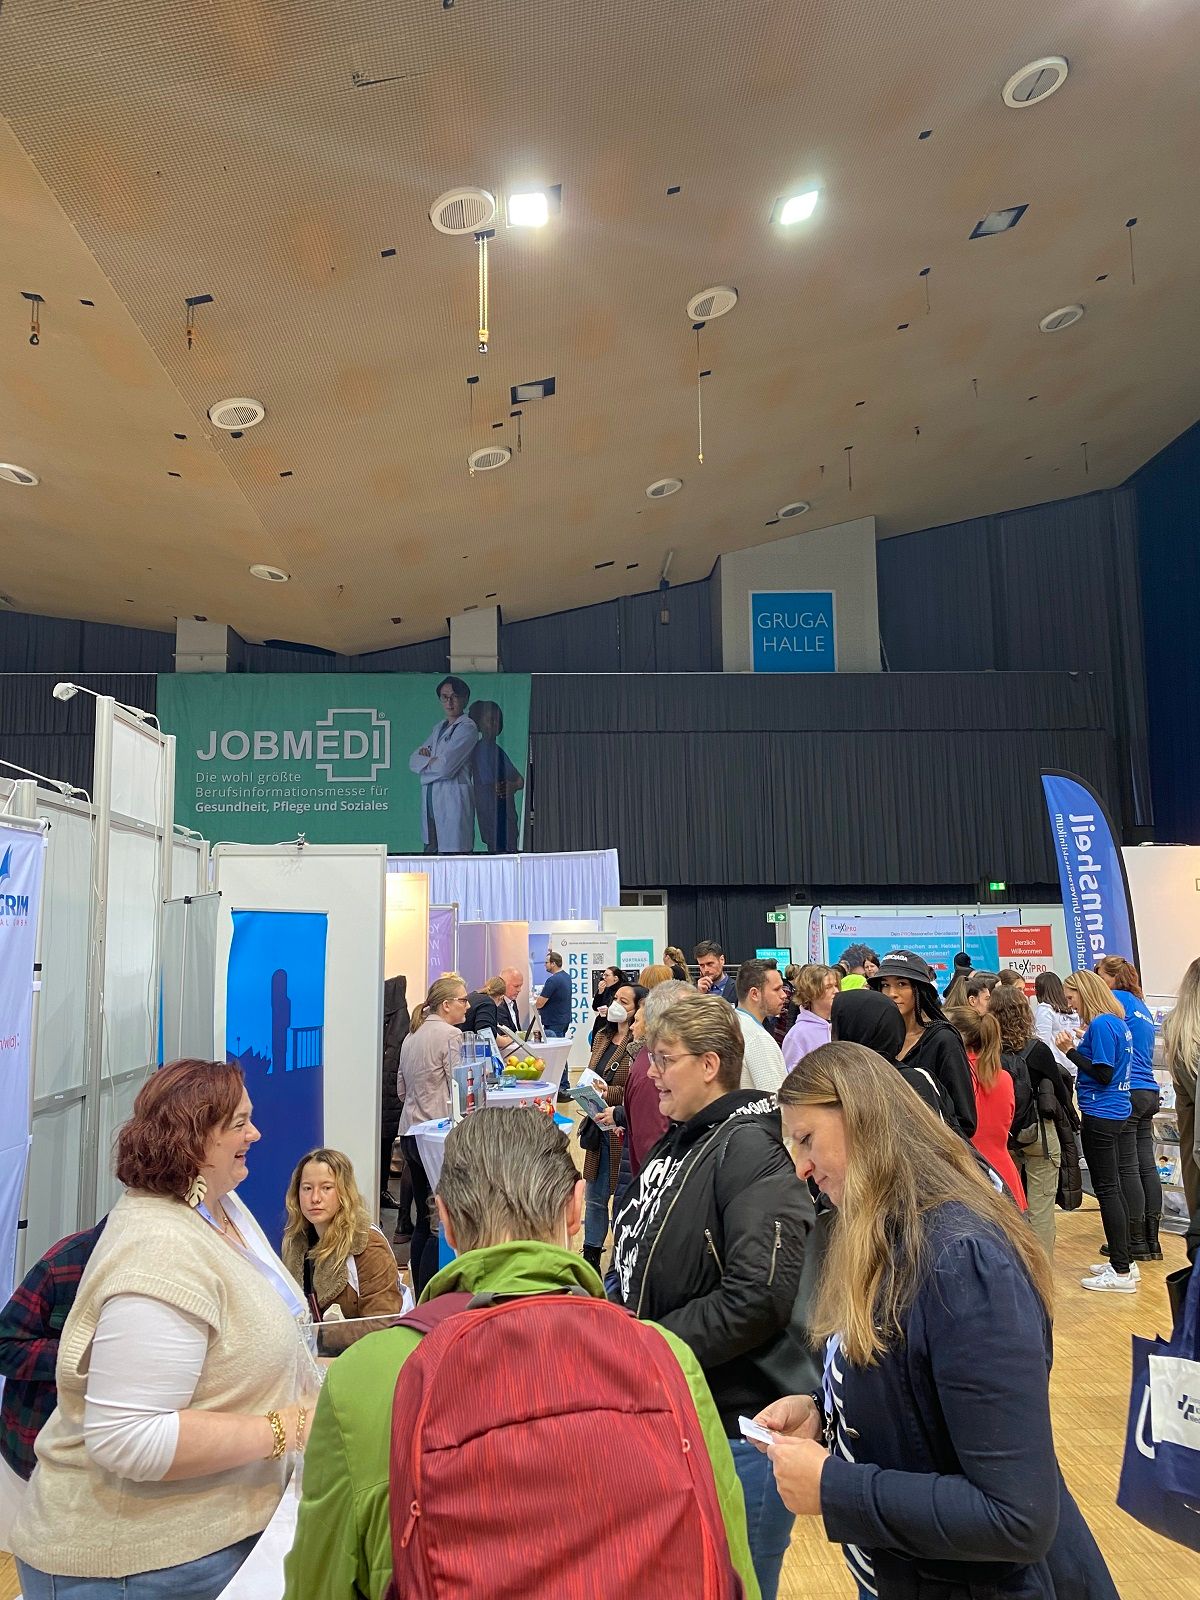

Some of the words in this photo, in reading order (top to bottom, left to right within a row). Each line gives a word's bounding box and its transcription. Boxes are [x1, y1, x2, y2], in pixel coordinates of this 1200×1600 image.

[757, 612, 829, 629] GRUGA
[763, 636, 825, 652] HALLE
[196, 730, 380, 761] JOBMEDI
[196, 772, 217, 783] Die
[222, 771, 253, 783] wohl
[258, 771, 302, 785] größte
[195, 786, 366, 798] Berufsinformationsmesse
[370, 785, 389, 796] für
[195, 801, 270, 814] Gesundheit,
[273, 801, 311, 814] Pflege
[314, 801, 337, 812] und
[340, 800, 389, 812] Soziales
